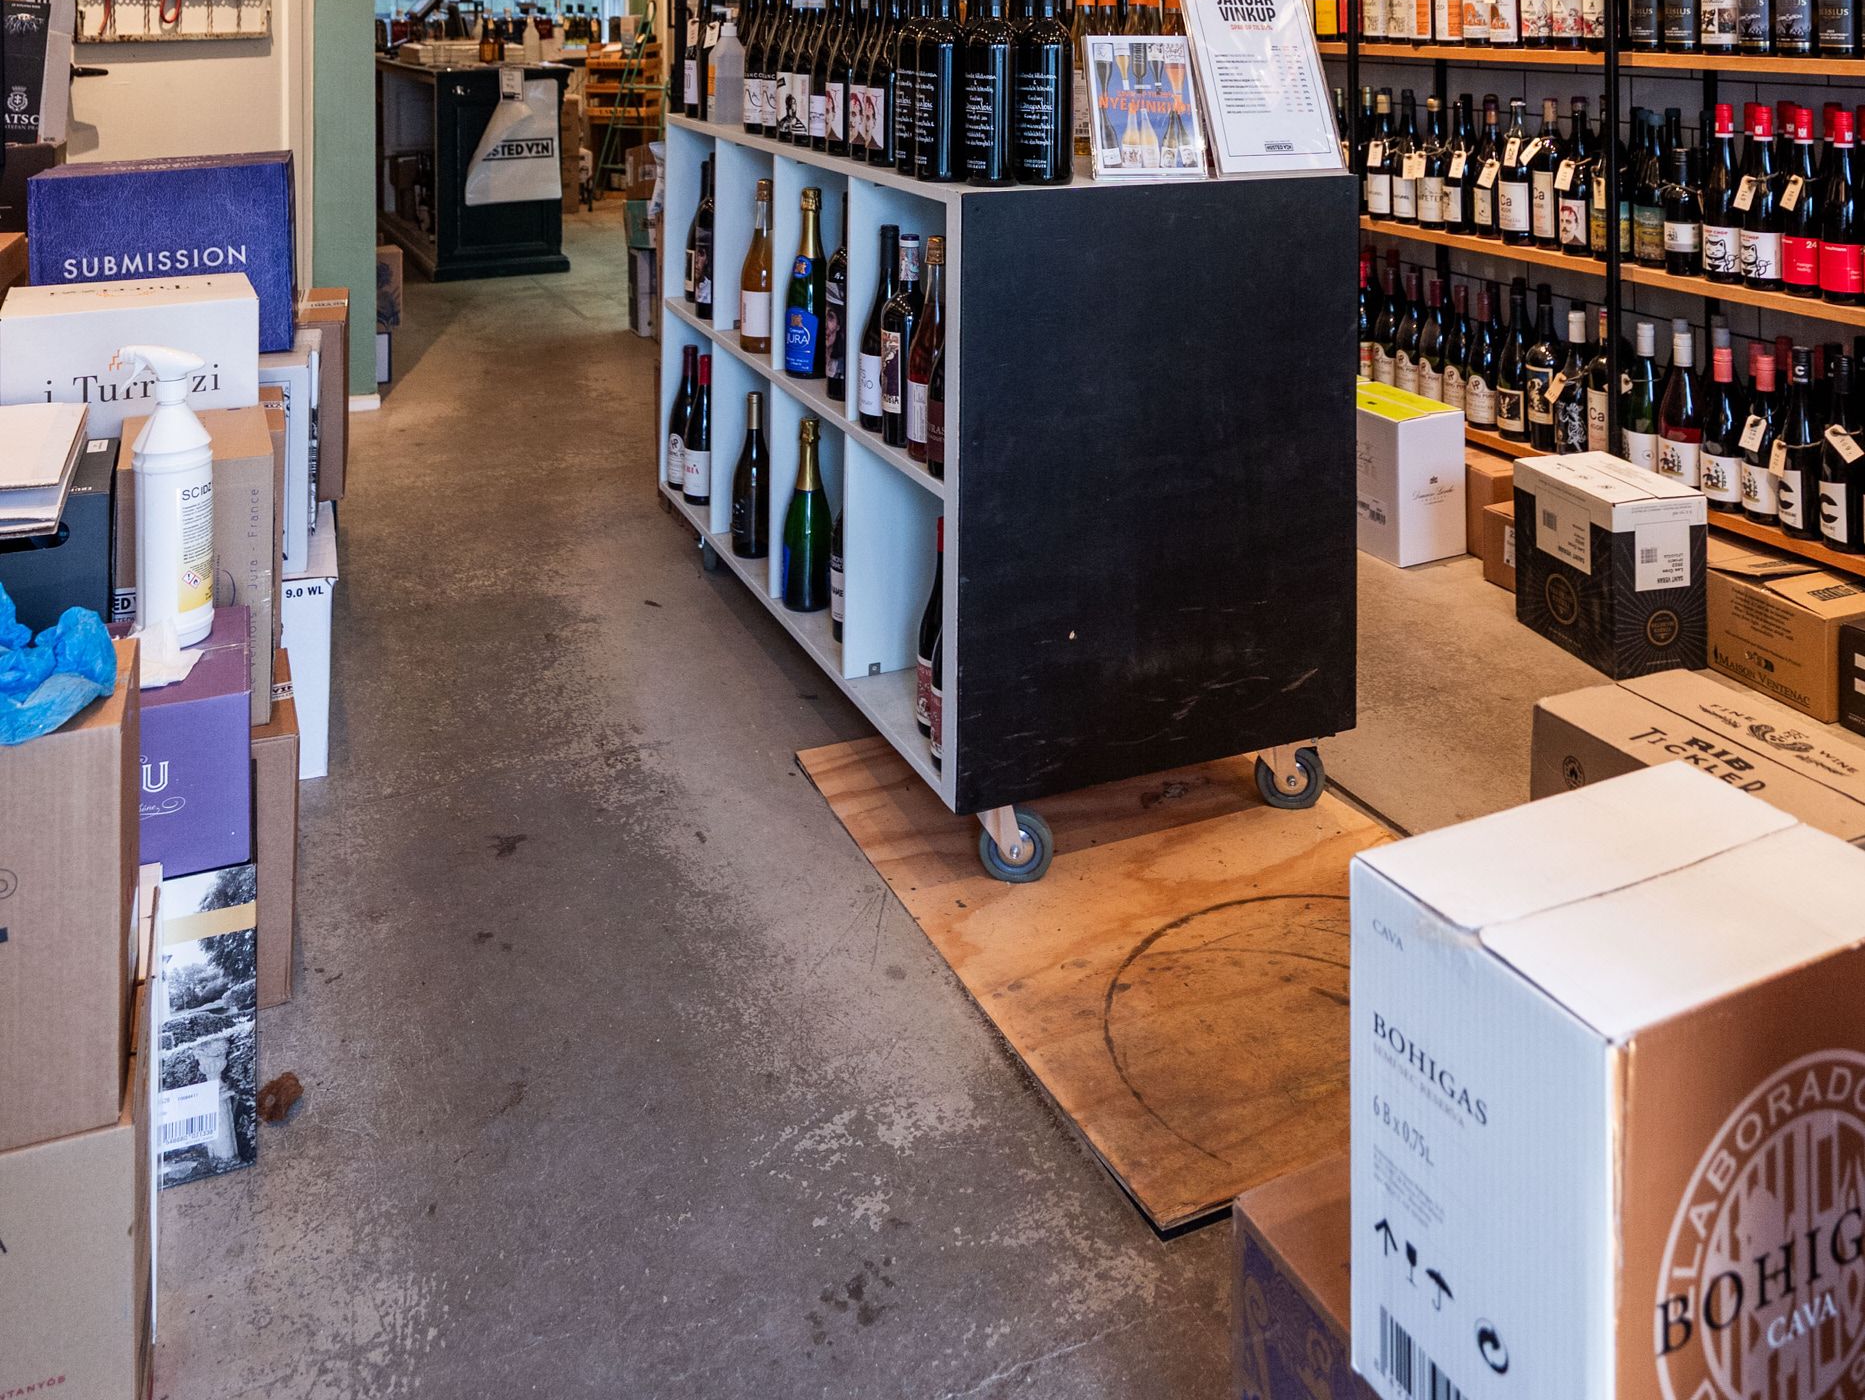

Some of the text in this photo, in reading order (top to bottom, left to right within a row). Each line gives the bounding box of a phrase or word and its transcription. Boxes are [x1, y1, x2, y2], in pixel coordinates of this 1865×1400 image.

[1219, 6, 1276, 22] VINKUP
[525, 141, 550, 155] VIN
[63, 244, 247, 280] SUBMISSION
[1589, 407, 1605, 422] Ca
[247, 488, 259, 538] France
[247, 560, 259, 590] Jura
[286, 586, 324, 599] 9.0 WL
[1719, 651, 1810, 704] MAISON VENTENAC
[1710, 703, 1758, 721] FINE
[1684, 735, 1756, 772] RIB
[1818, 749, 1859, 774] WINE
[1372, 918, 1404, 952] CAVA
[1374, 1010, 1488, 1127] BOHIGAS
[1766, 1292, 1838, 1350] CAVA
